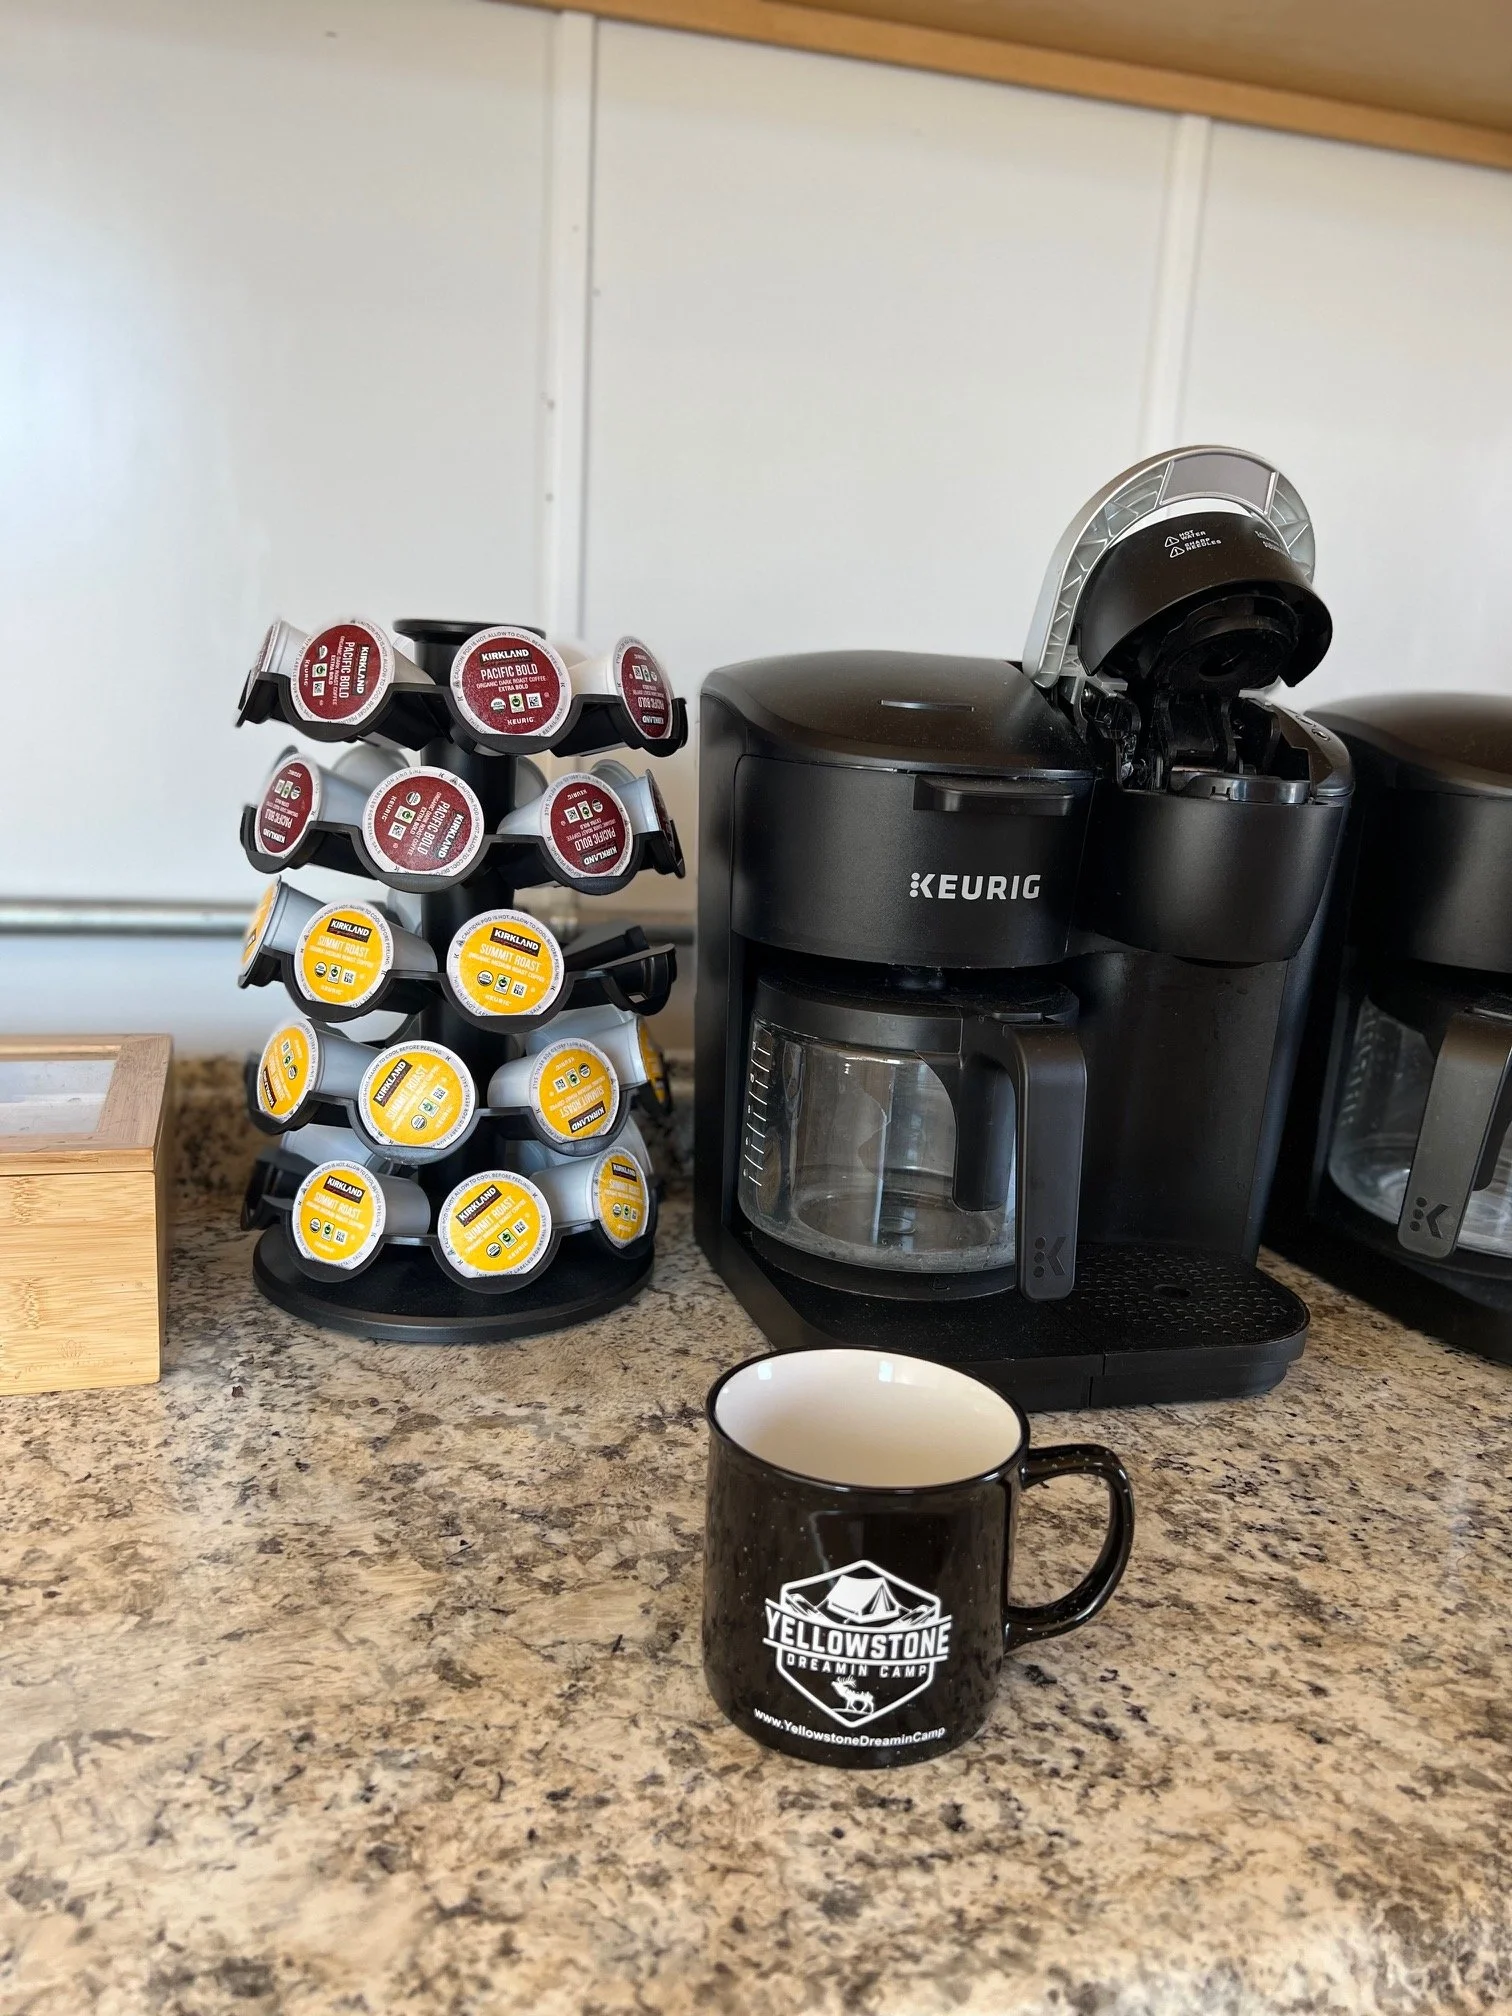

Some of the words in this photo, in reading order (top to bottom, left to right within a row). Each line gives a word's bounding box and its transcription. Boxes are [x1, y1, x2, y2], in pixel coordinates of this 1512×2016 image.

[341, 641, 354, 673] PACIFIC
[481, 649, 529, 661] KIRKLAND
[355, 645, 368, 694] KIRKLAND
[480, 665, 514, 680] PACIFIC
[515, 663, 538, 676] BOLD
[338, 675, 350, 698] BOLD
[506, 716, 535, 725] KEURIG
[565, 786, 587, 802] KEURIG
[380, 794, 397, 822] KEURIG
[415, 805, 427, 822] EXTRA
[426, 800, 450, 833] PACIFIC
[262, 826, 286, 844] KIRKLAND
[408, 820, 420, 835] BOLD
[414, 822, 425, 838] ROAST
[436, 812, 464, 859] KIRKLAND
[591, 824, 617, 845] PACIFIC
[416, 831, 435, 855] BOLD
[573, 834, 593, 852] BOLD
[582, 844, 618, 866] KIRKLAND
[910, 872, 1041, 900] KEURIG
[330, 919, 369, 937] KIRKLAND
[493, 929, 539, 950] KIRKLAND
[316, 934, 343, 951] SUMMIT
[342, 942, 369, 959] ROAST
[478, 942, 513, 963] SUMMIT
[512, 954, 541, 972] ROAST
[374, 1060, 407, 1101] KIRKLAND
[580, 1084, 604, 1105] SUMMIT
[557, 1097, 581, 1119] ROAST
[570, 1106, 605, 1131] KIRKLAND
[326, 1177, 363, 1198] KIRKLAND
[456, 1185, 498, 1221] KIRKLAND
[462, 1214, 495, 1242] SUMMIT
[489, 1194, 516, 1219] ROAST
[765, 1606, 951, 1659] YELLOWSTONE
[787, 1654, 867, 1676] DREAMIN
[880, 1665, 927, 1678] CAMP
[754, 1708, 946, 1747] www.YellowstoneDreaminCamp
